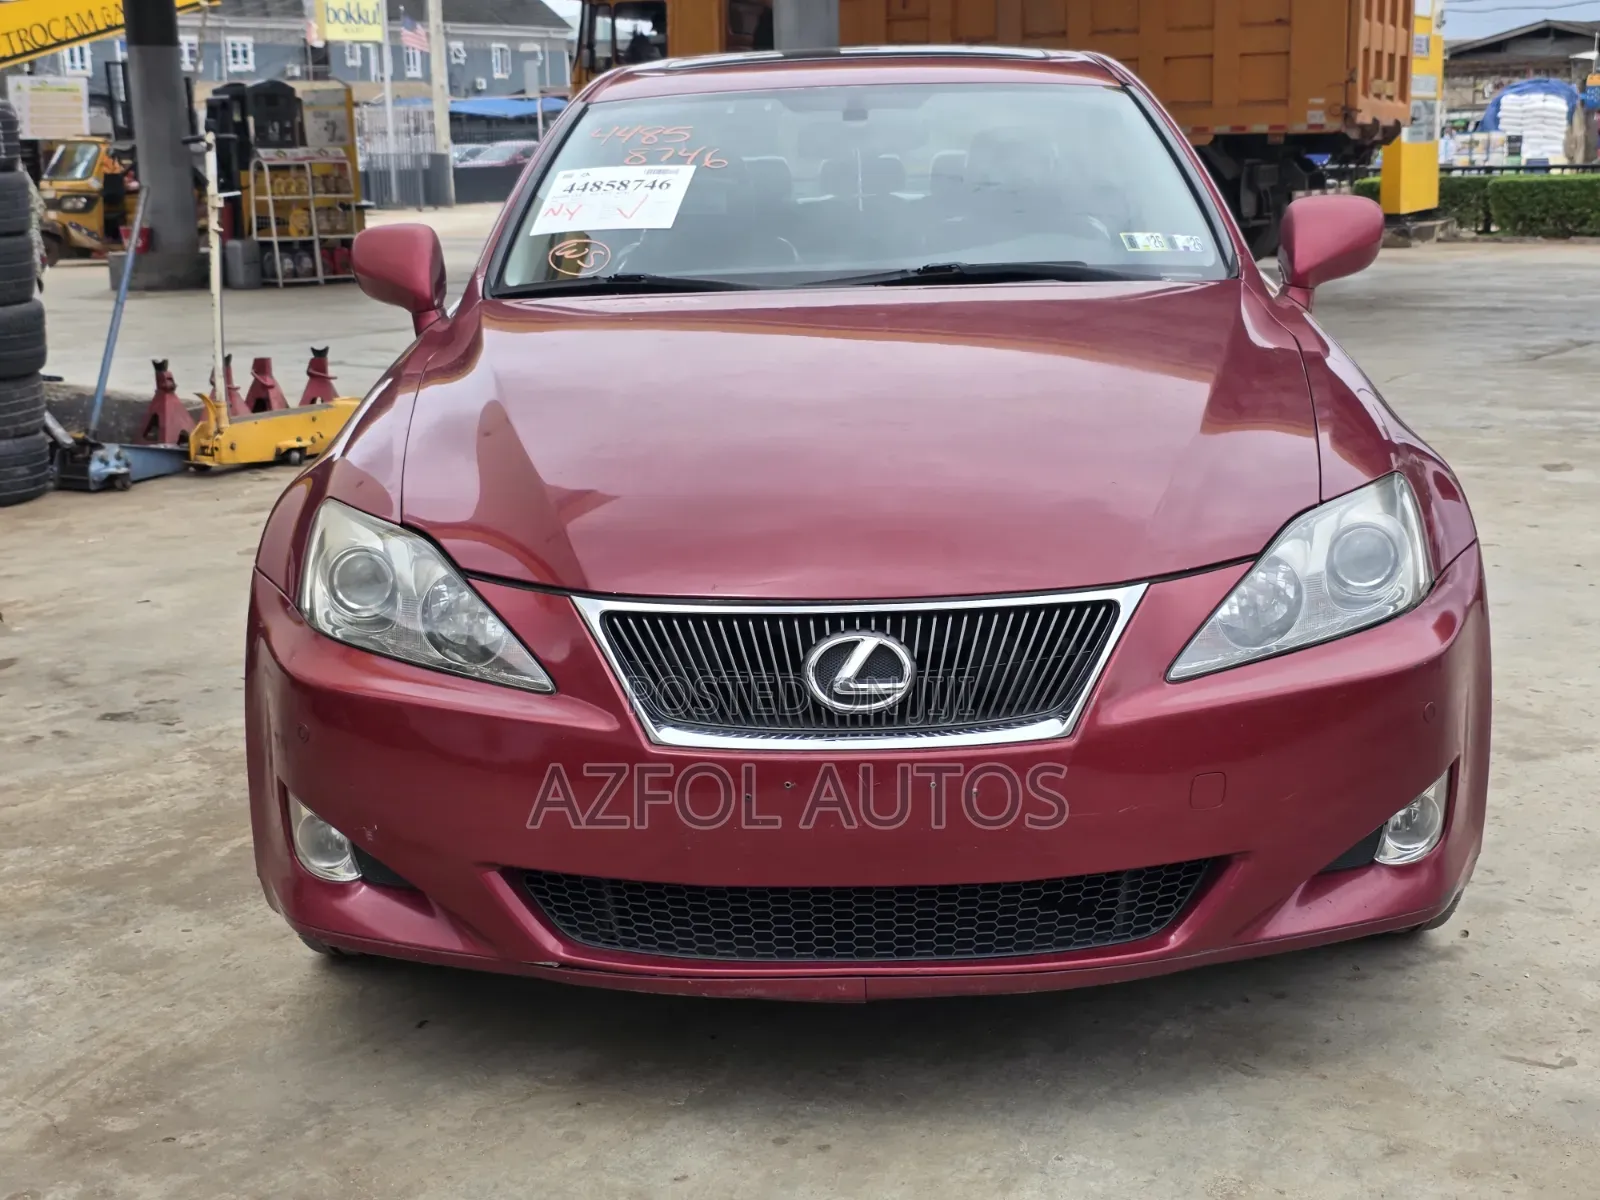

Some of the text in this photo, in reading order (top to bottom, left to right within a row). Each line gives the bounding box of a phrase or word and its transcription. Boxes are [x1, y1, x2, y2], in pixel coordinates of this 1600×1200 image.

[326, 1, 381, 25] bokku!
[0, 9, 99, 56] TROCAM
[591, 125, 693, 146] 4485
[624, 146, 728, 168] 8746
[563, 178, 672, 194] 44858746
[543, 203, 583, 221] NY
